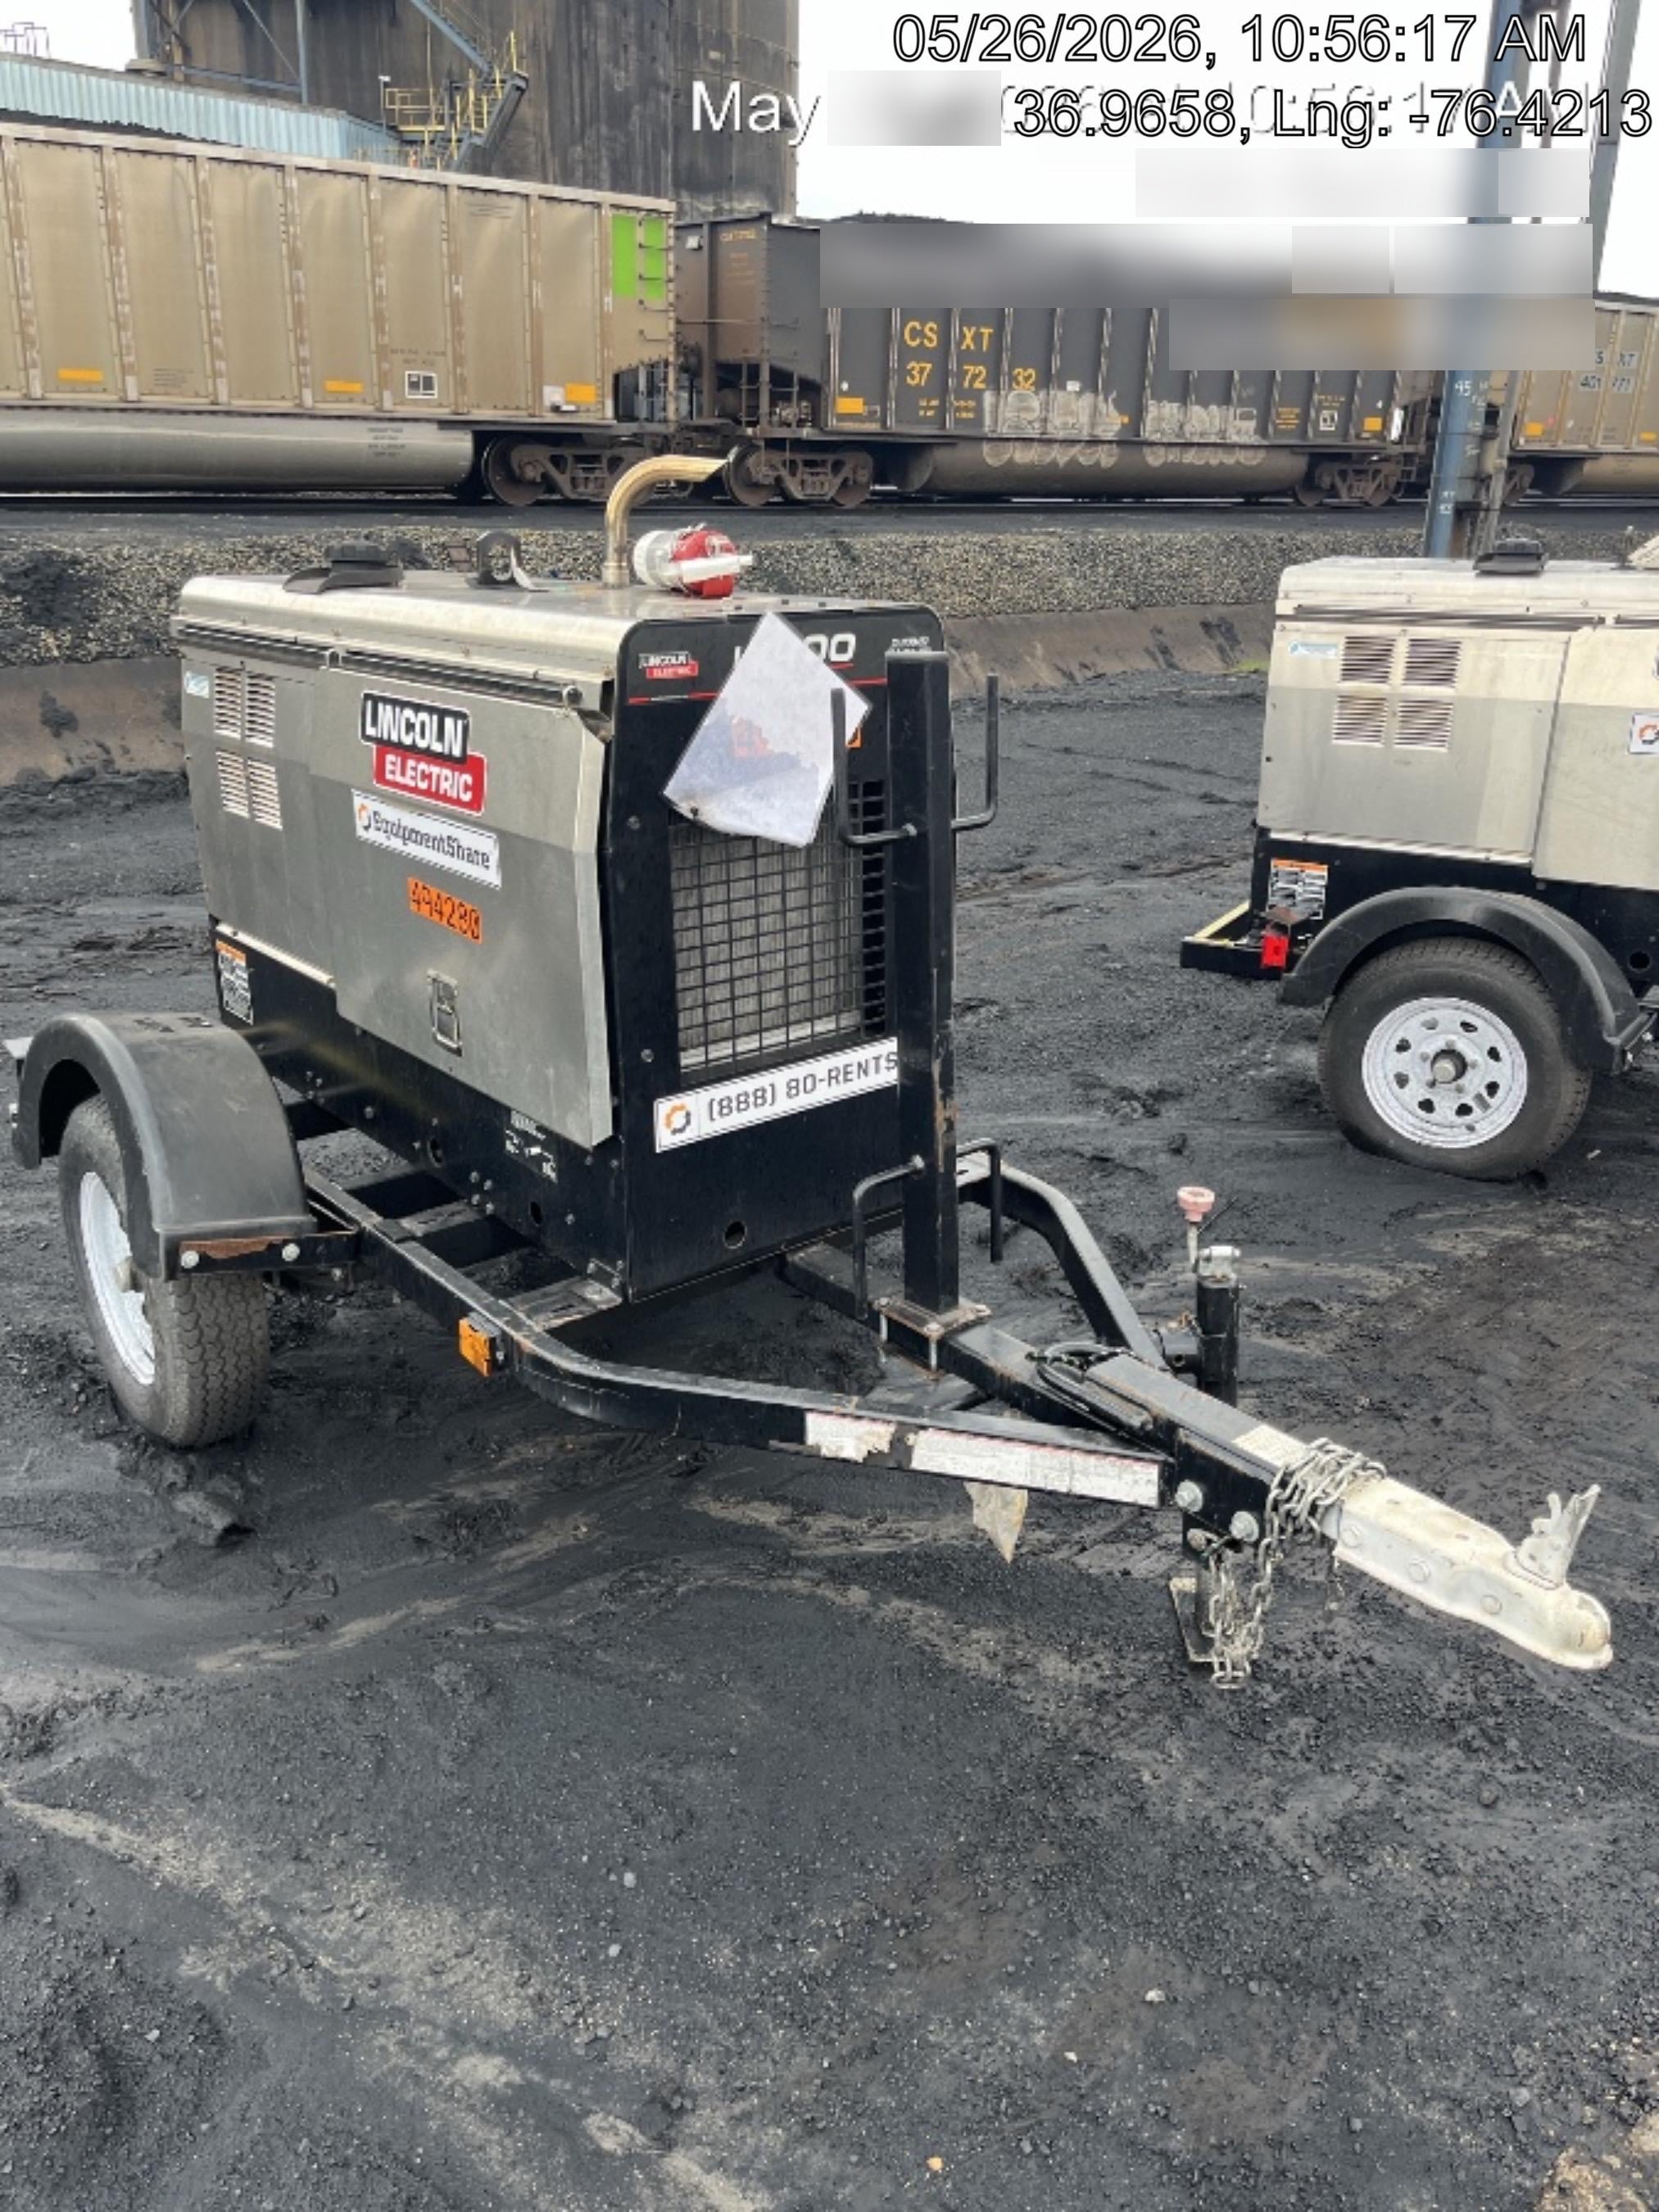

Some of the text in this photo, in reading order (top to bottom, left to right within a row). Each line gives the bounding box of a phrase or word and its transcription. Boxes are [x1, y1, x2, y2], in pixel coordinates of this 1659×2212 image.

[904, 321, 994, 353] CS XT
[906, 361, 1036, 392] 37 72 32
[365, 700, 465, 758] LINCOLN
[384, 753, 474, 802] ELECTRIC
[372, 810, 491, 869] EquipmentShare
